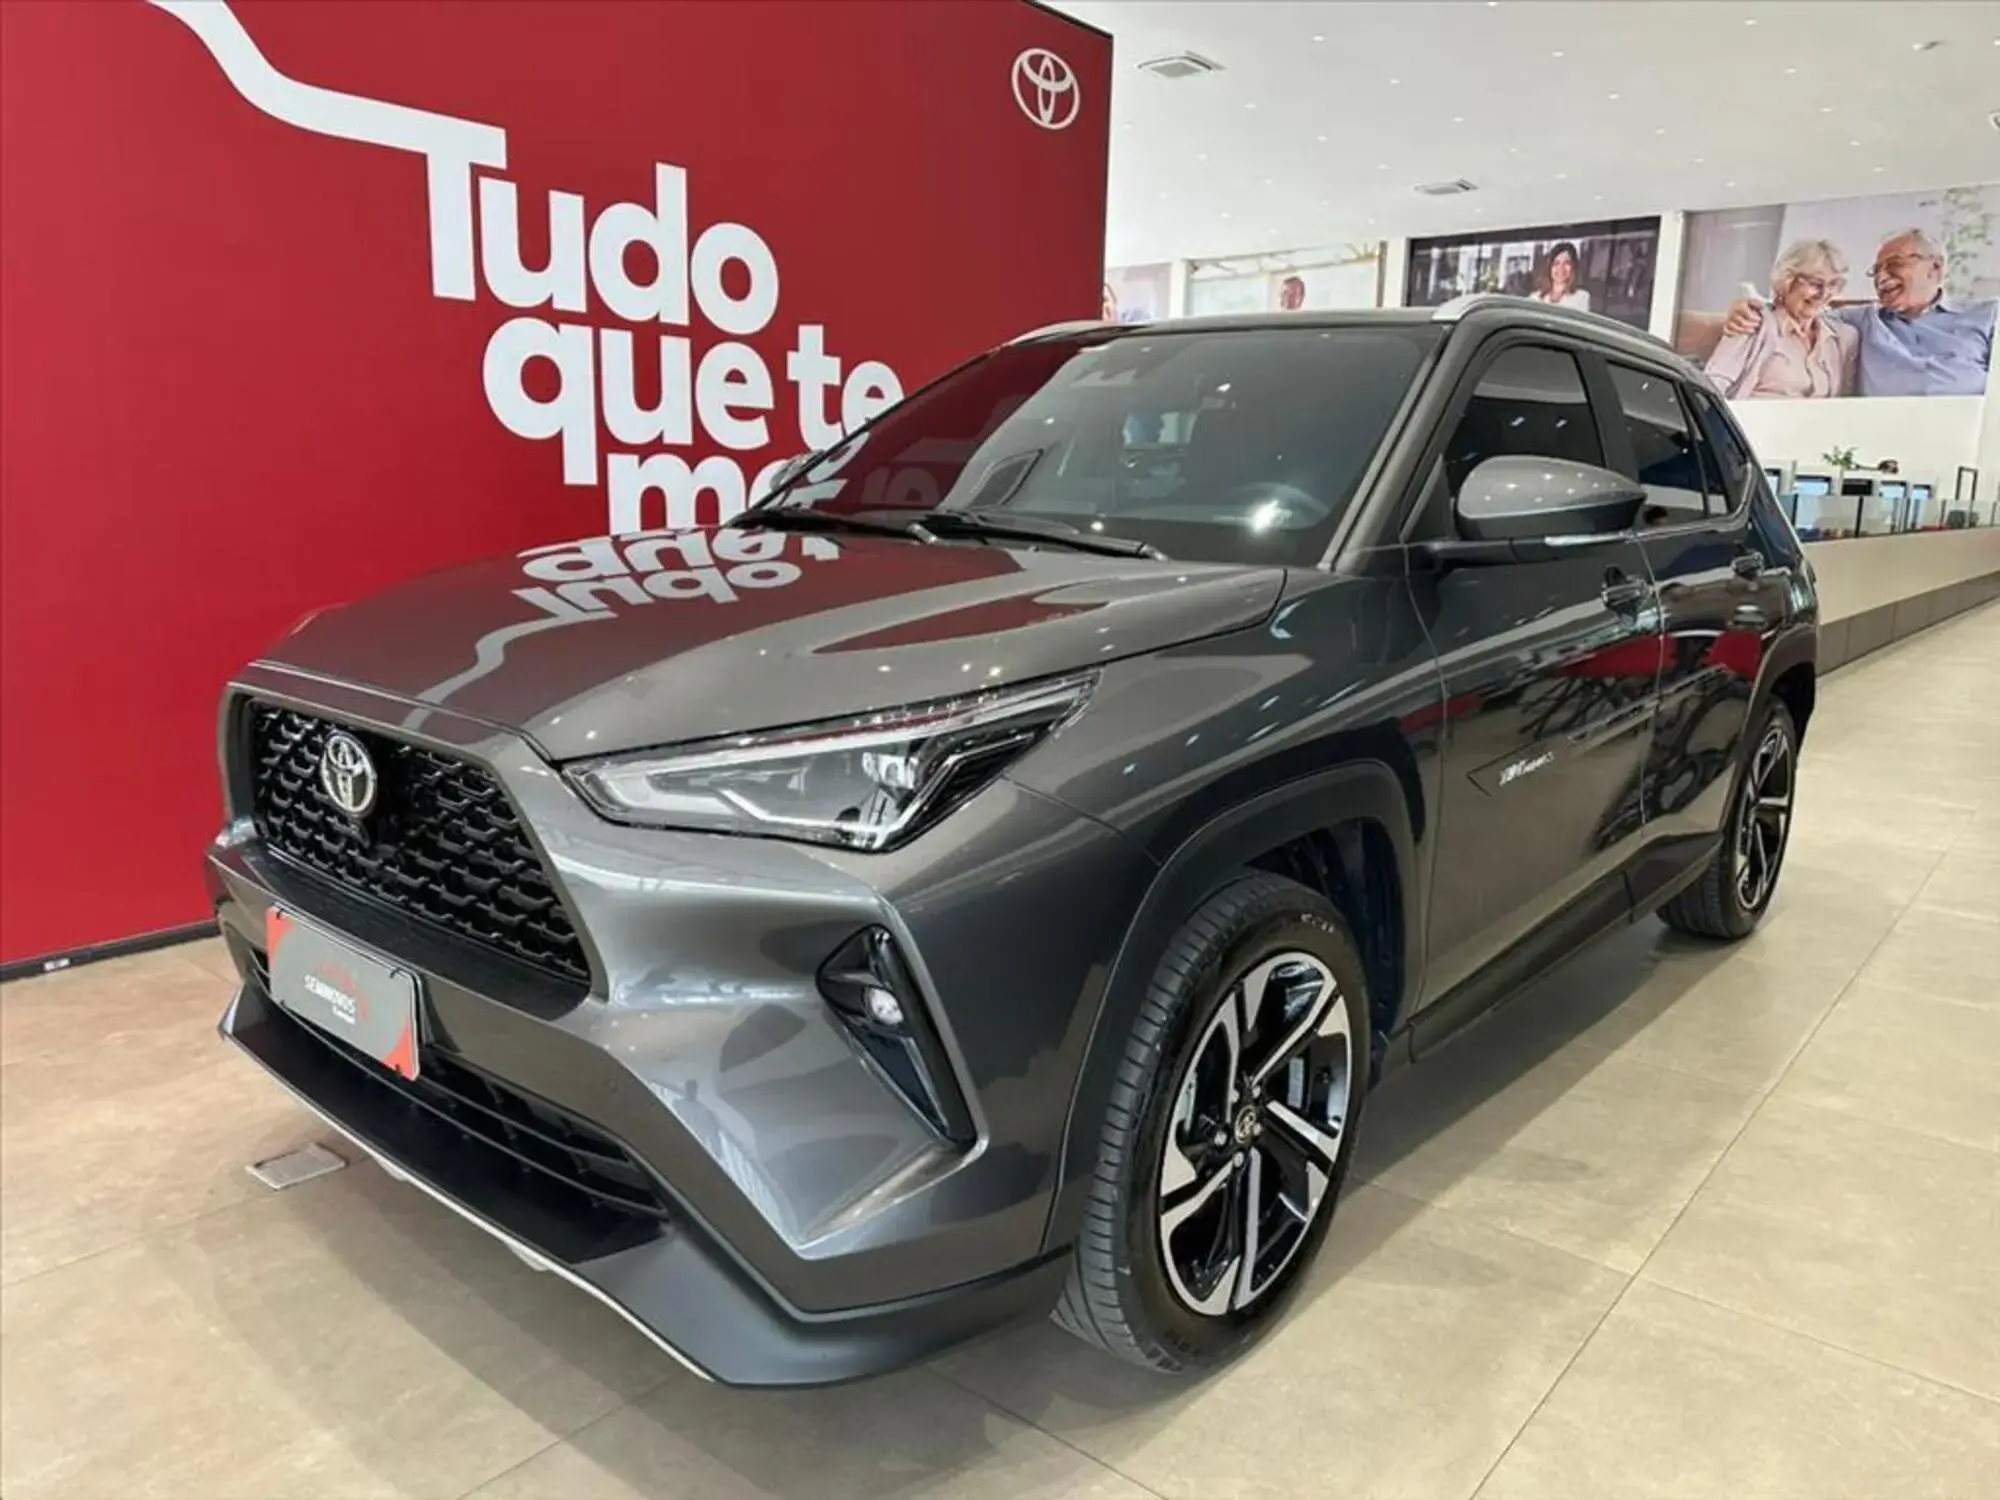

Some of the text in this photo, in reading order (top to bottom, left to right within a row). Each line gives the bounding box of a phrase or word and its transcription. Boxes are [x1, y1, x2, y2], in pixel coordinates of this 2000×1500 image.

[400, 106, 780, 335] Tudo
[482, 316, 905, 486] que te
